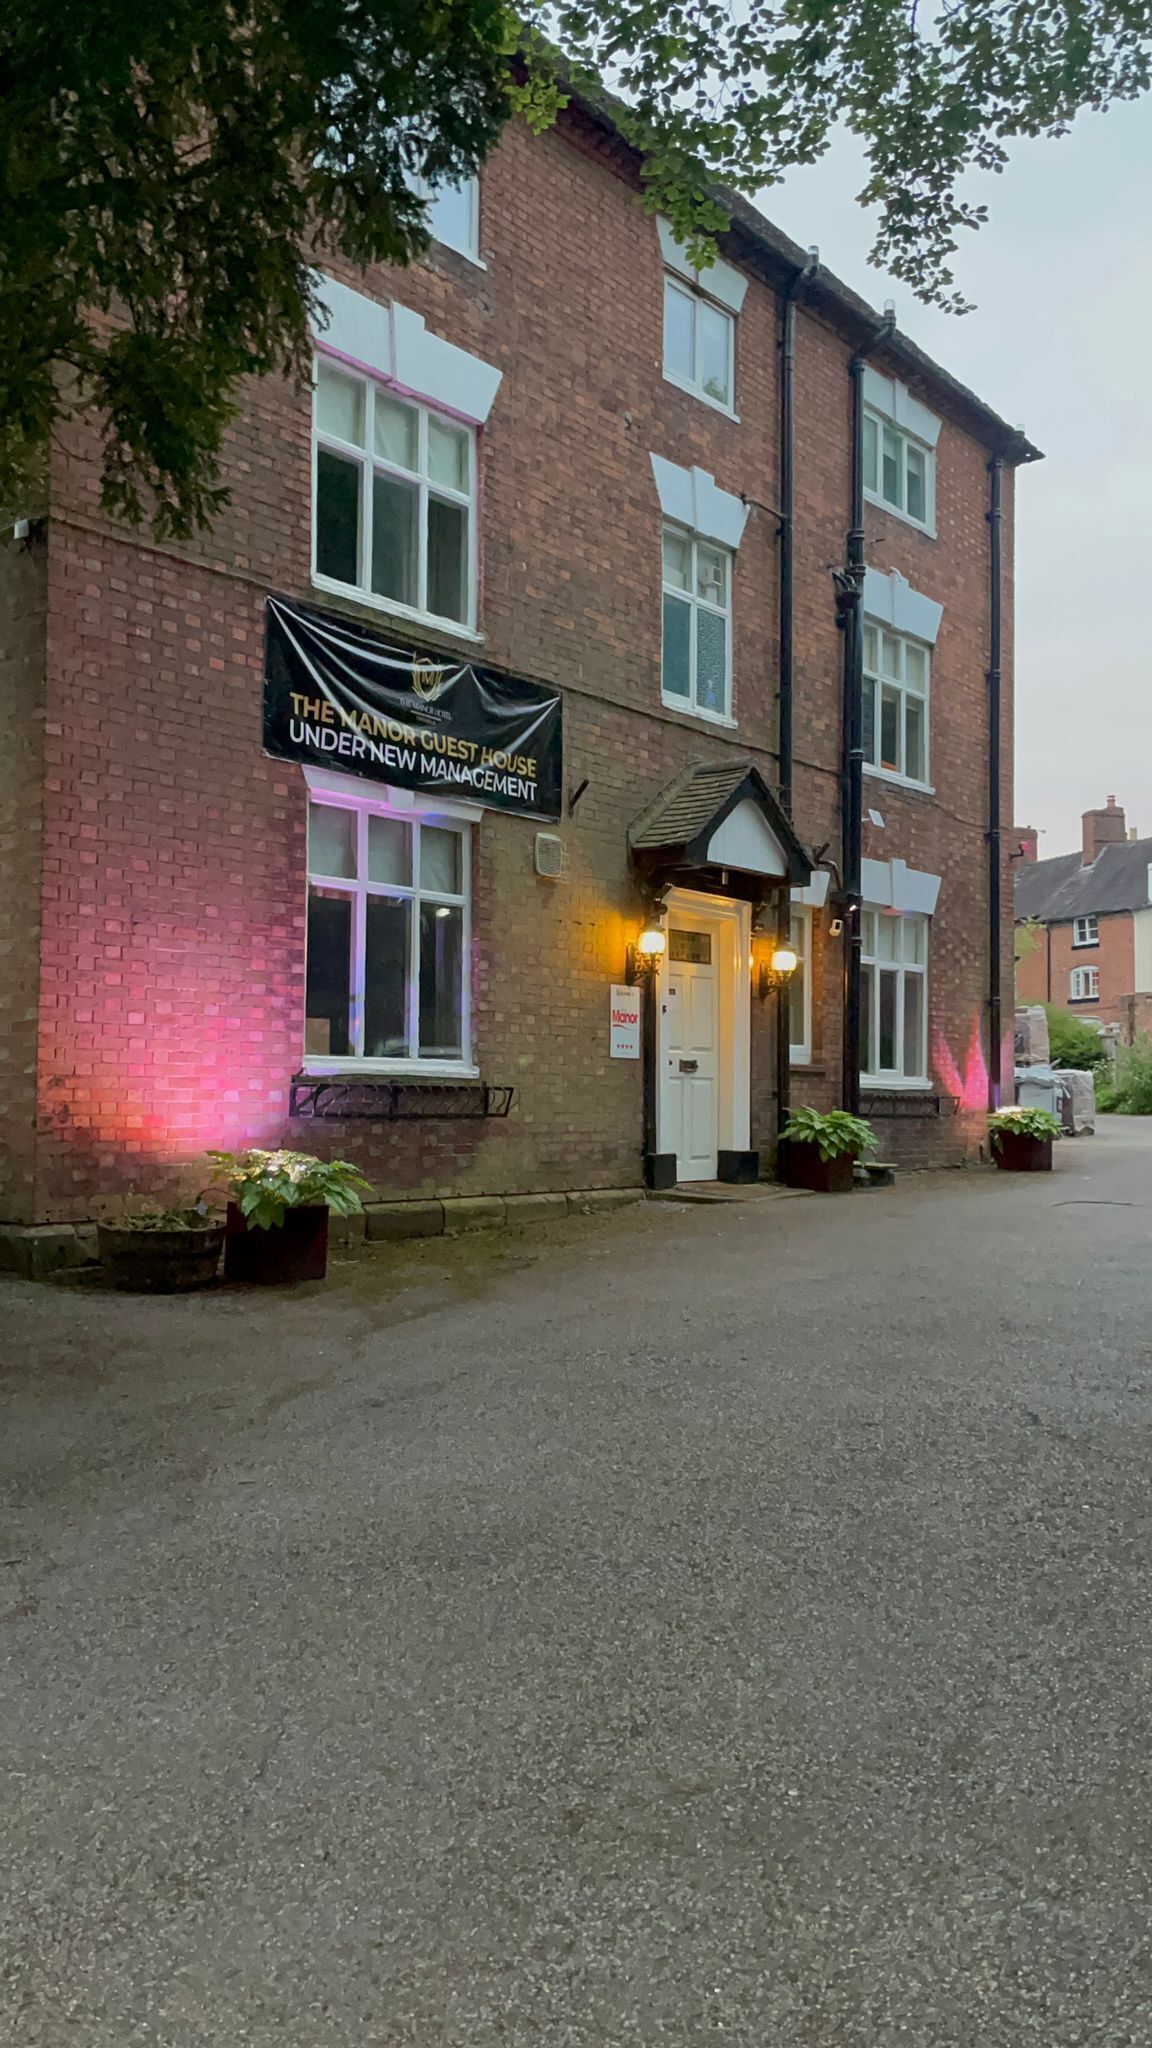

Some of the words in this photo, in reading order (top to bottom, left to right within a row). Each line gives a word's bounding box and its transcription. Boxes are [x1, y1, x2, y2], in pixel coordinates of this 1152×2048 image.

[289, 692, 335, 724] THE
[341, 710, 416, 746] MANOR
[420, 730, 478, 762] GUEST
[481, 746, 537, 778] HOUSE
[289, 719, 366, 759] UNDER
[370, 740, 417, 771] NEW
[420, 753, 537, 801] MANAGEMENT
[612, 1009, 638, 1024] Manor
